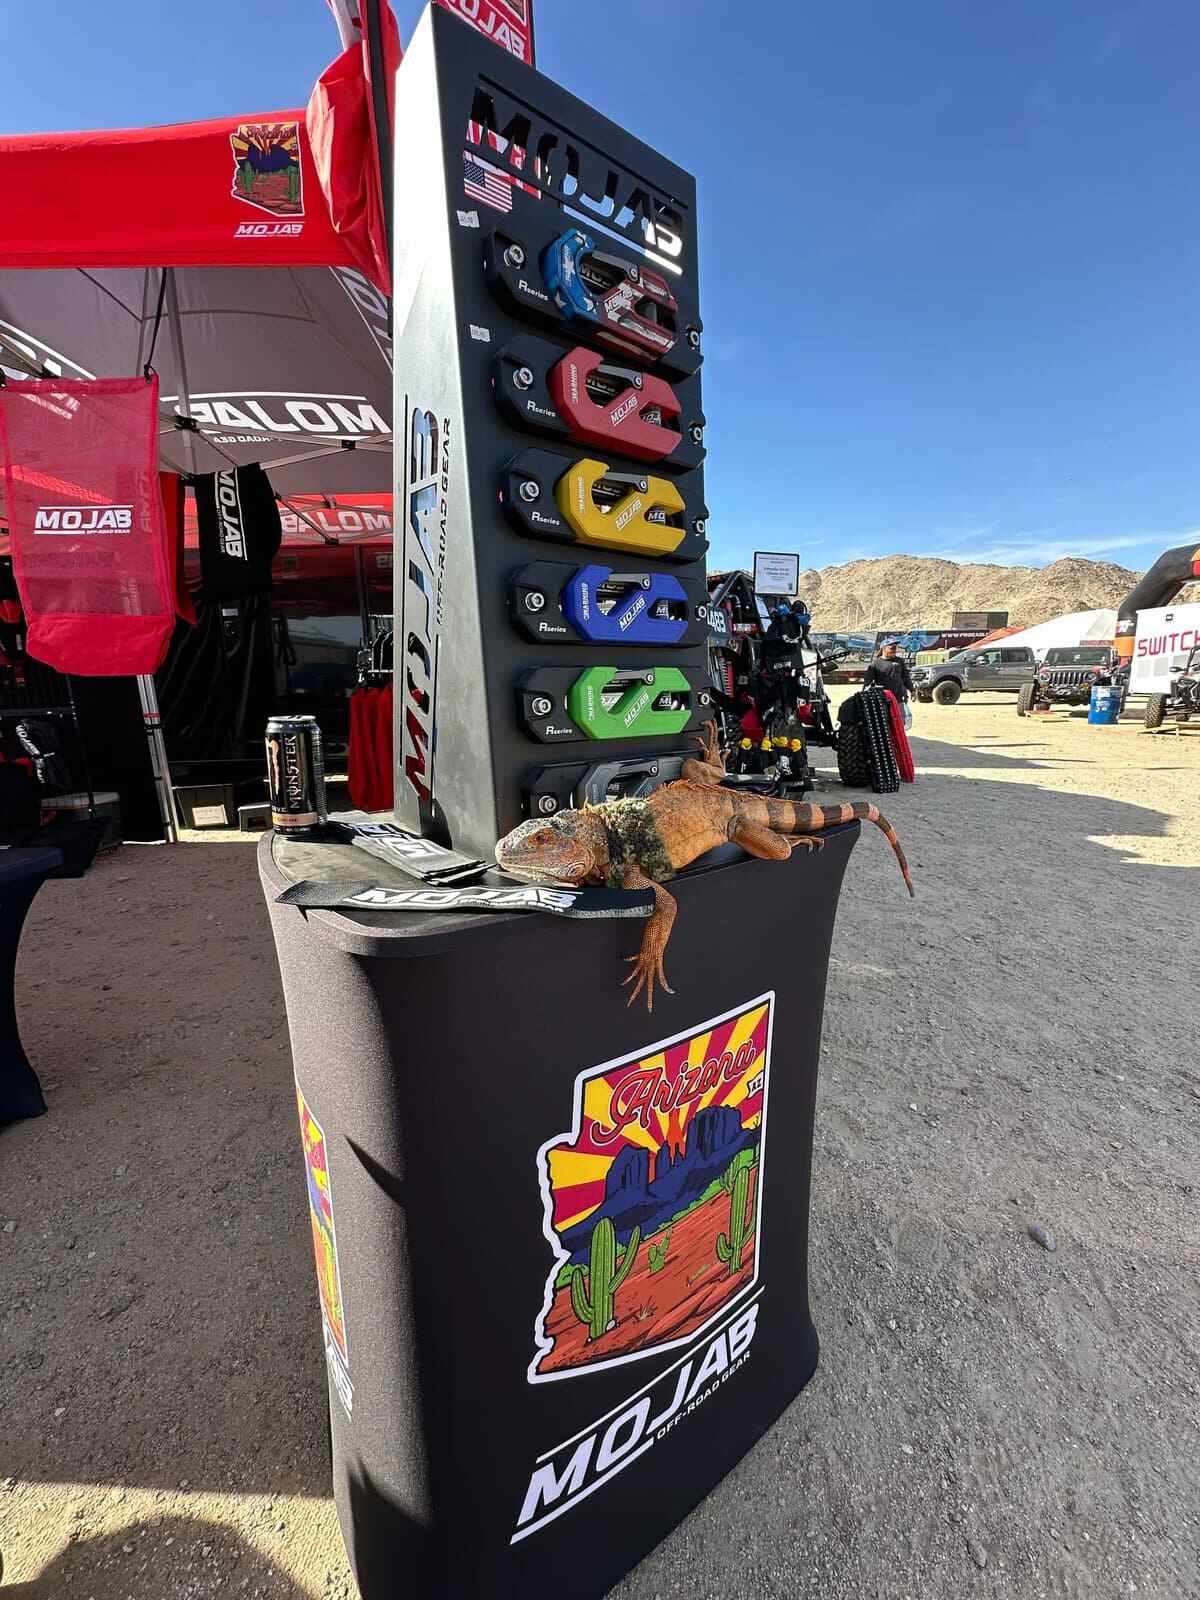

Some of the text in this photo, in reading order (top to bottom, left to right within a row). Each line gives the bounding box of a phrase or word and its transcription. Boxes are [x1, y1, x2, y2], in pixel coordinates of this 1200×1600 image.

[448, 0, 525, 60] OJAB
[465, 87, 683, 257] MOJAB
[235, 224, 303, 235] MOJAB
[610, 396, 638, 424] MOJAB
[441, 417, 450, 493] GEAR
[35, 510, 132, 529] MOJAB
[219, 470, 243, 558] MOJAB
[405, 407, 439, 810] MOJAB
[618, 597, 645, 630] MOJAB
[623, 691, 650, 726] MOJAB
[285, 735, 302, 809] MONSTER
[352, 888, 577, 908] MOJAB
[591, 1039, 756, 1146] Arizona
[516, 1303, 760, 1527] MOJAB
[657, 1350, 751, 1440] OFF-ROAD GEAR
